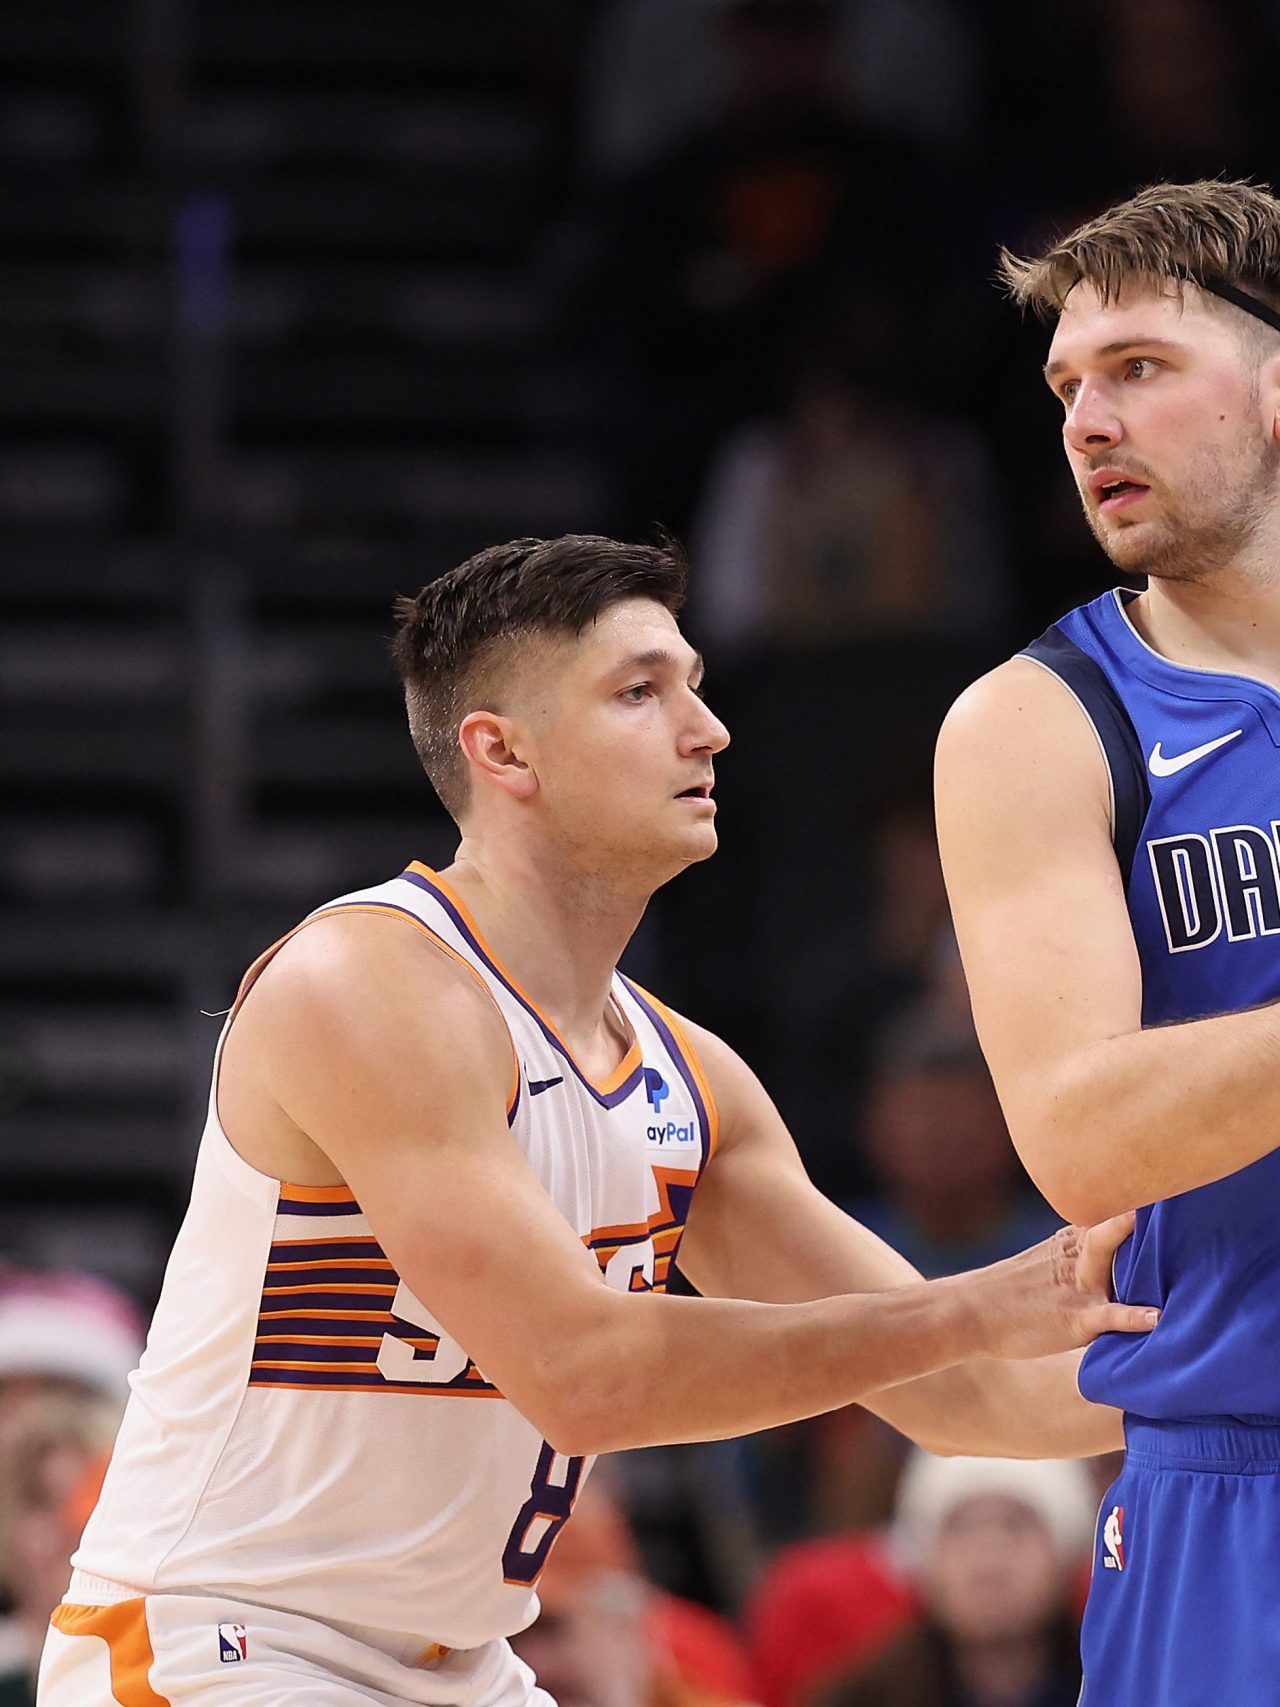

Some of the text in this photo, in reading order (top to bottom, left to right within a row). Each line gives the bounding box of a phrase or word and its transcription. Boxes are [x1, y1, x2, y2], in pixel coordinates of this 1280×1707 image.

[646, 1121, 695, 1145] ayPal
[501, 1438, 587, 1588] 8
[223, 1650, 239, 1662] NBA
